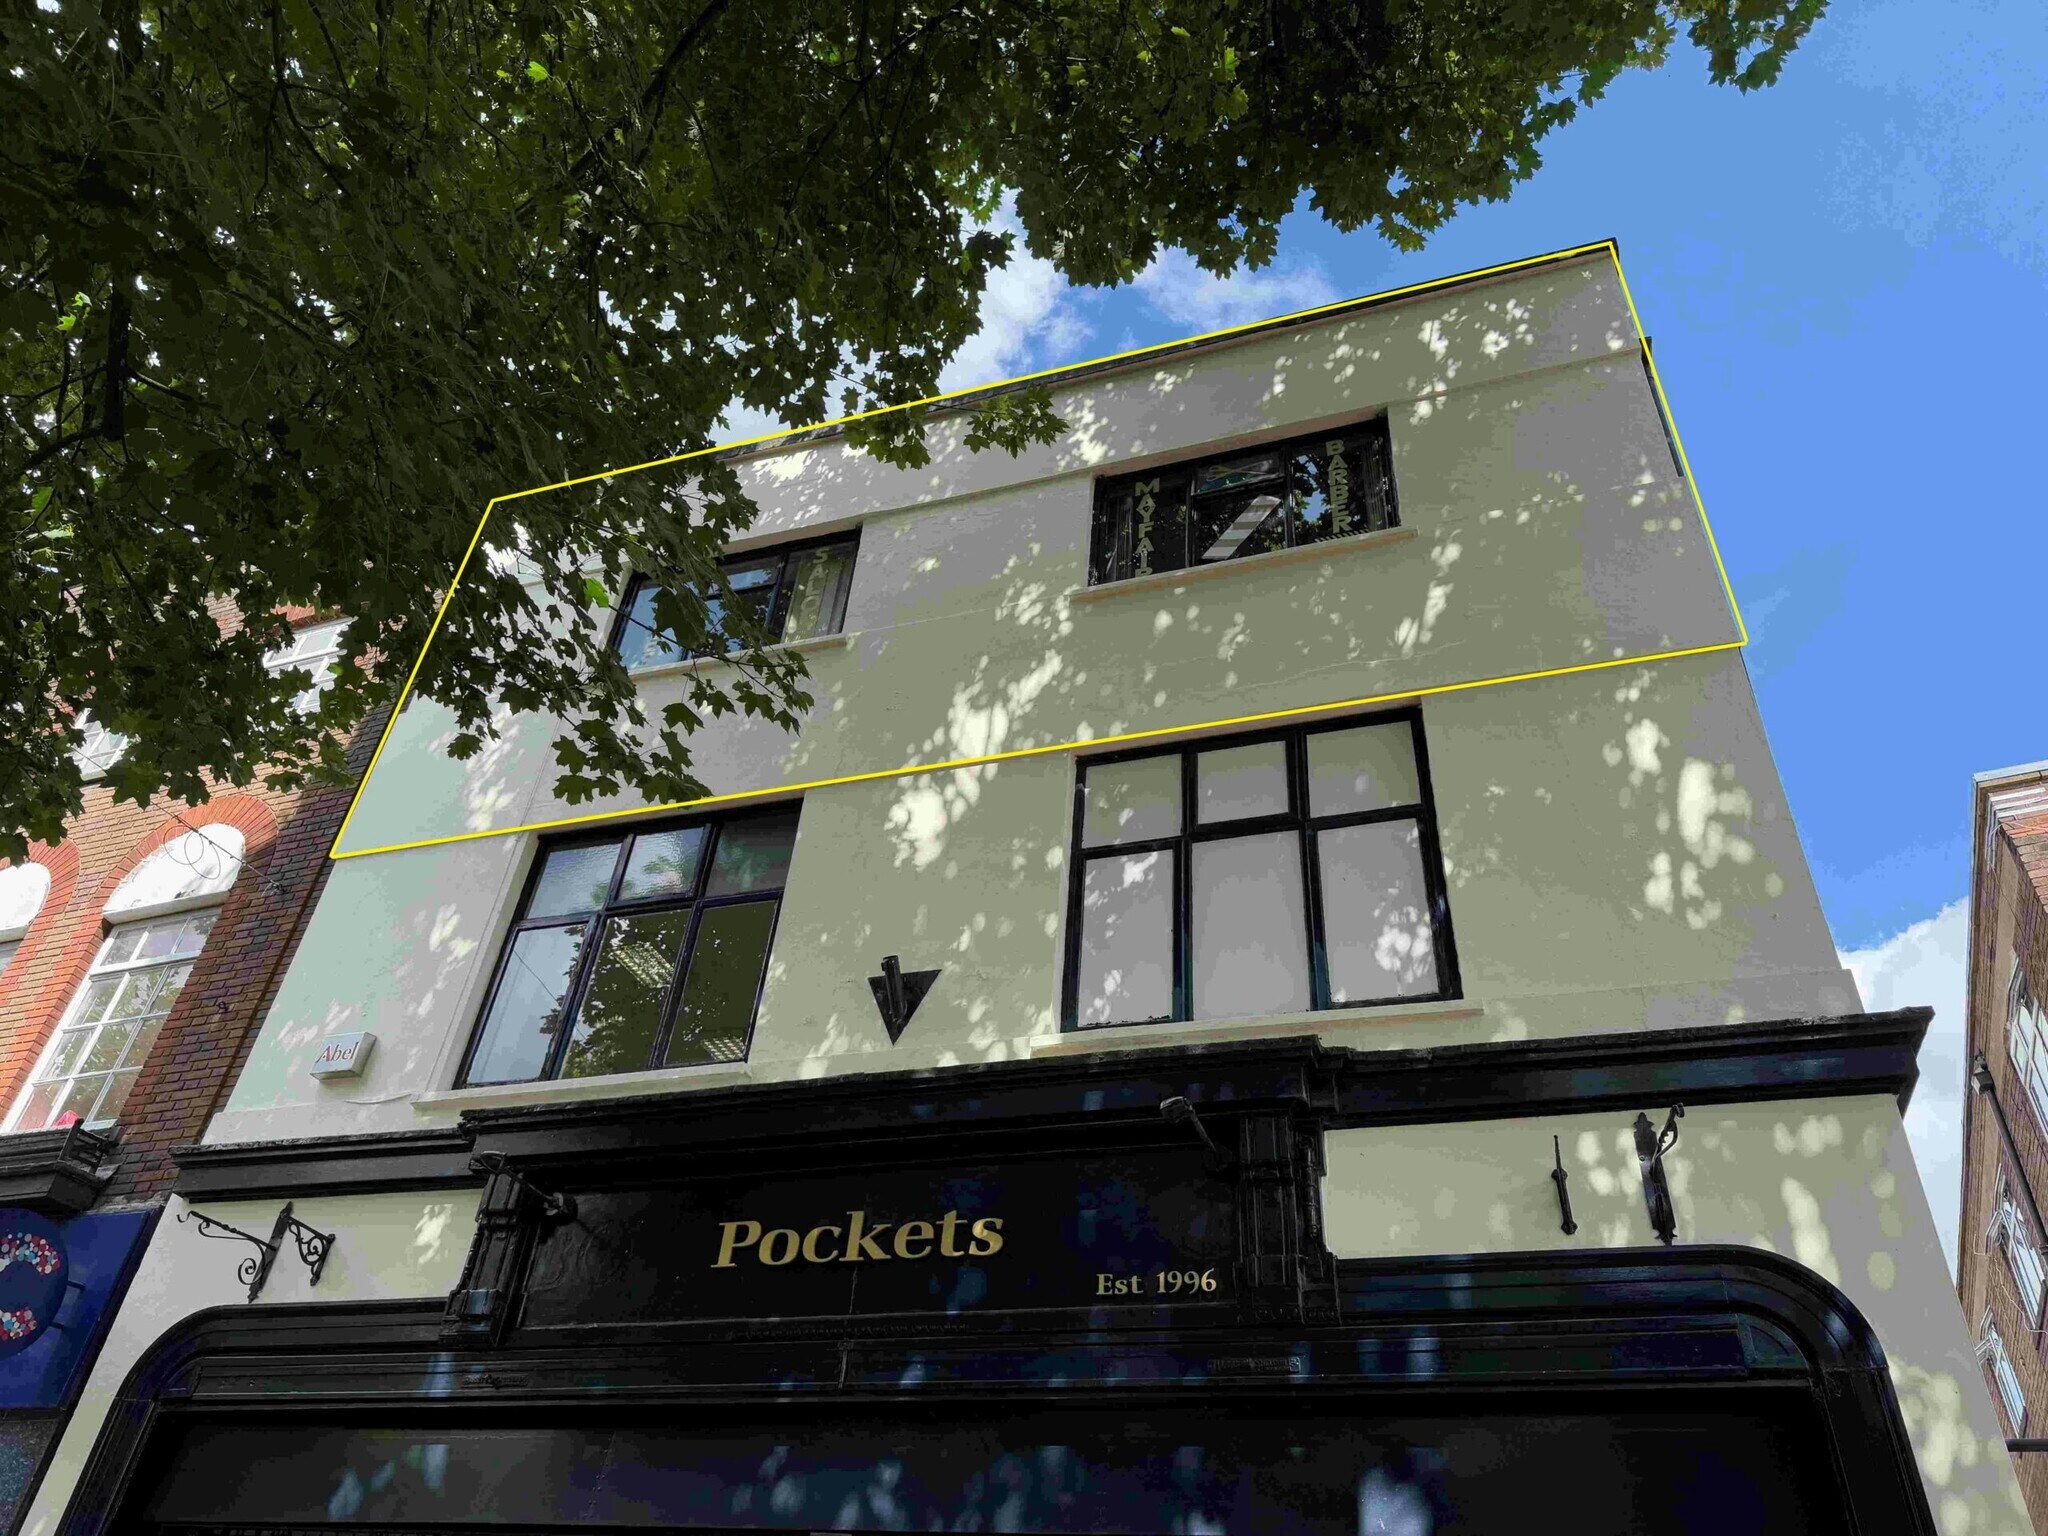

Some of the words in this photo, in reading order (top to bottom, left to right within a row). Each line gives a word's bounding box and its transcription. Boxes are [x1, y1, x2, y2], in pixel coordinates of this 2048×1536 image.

[1325, 439, 1353, 534] BARBER
[315, 1041, 360, 1063] Abel
[710, 1210, 1004, 1268] Pockets
[1096, 1274, 1144, 1296] Est
[1156, 1267, 1217, 1295] 1996
